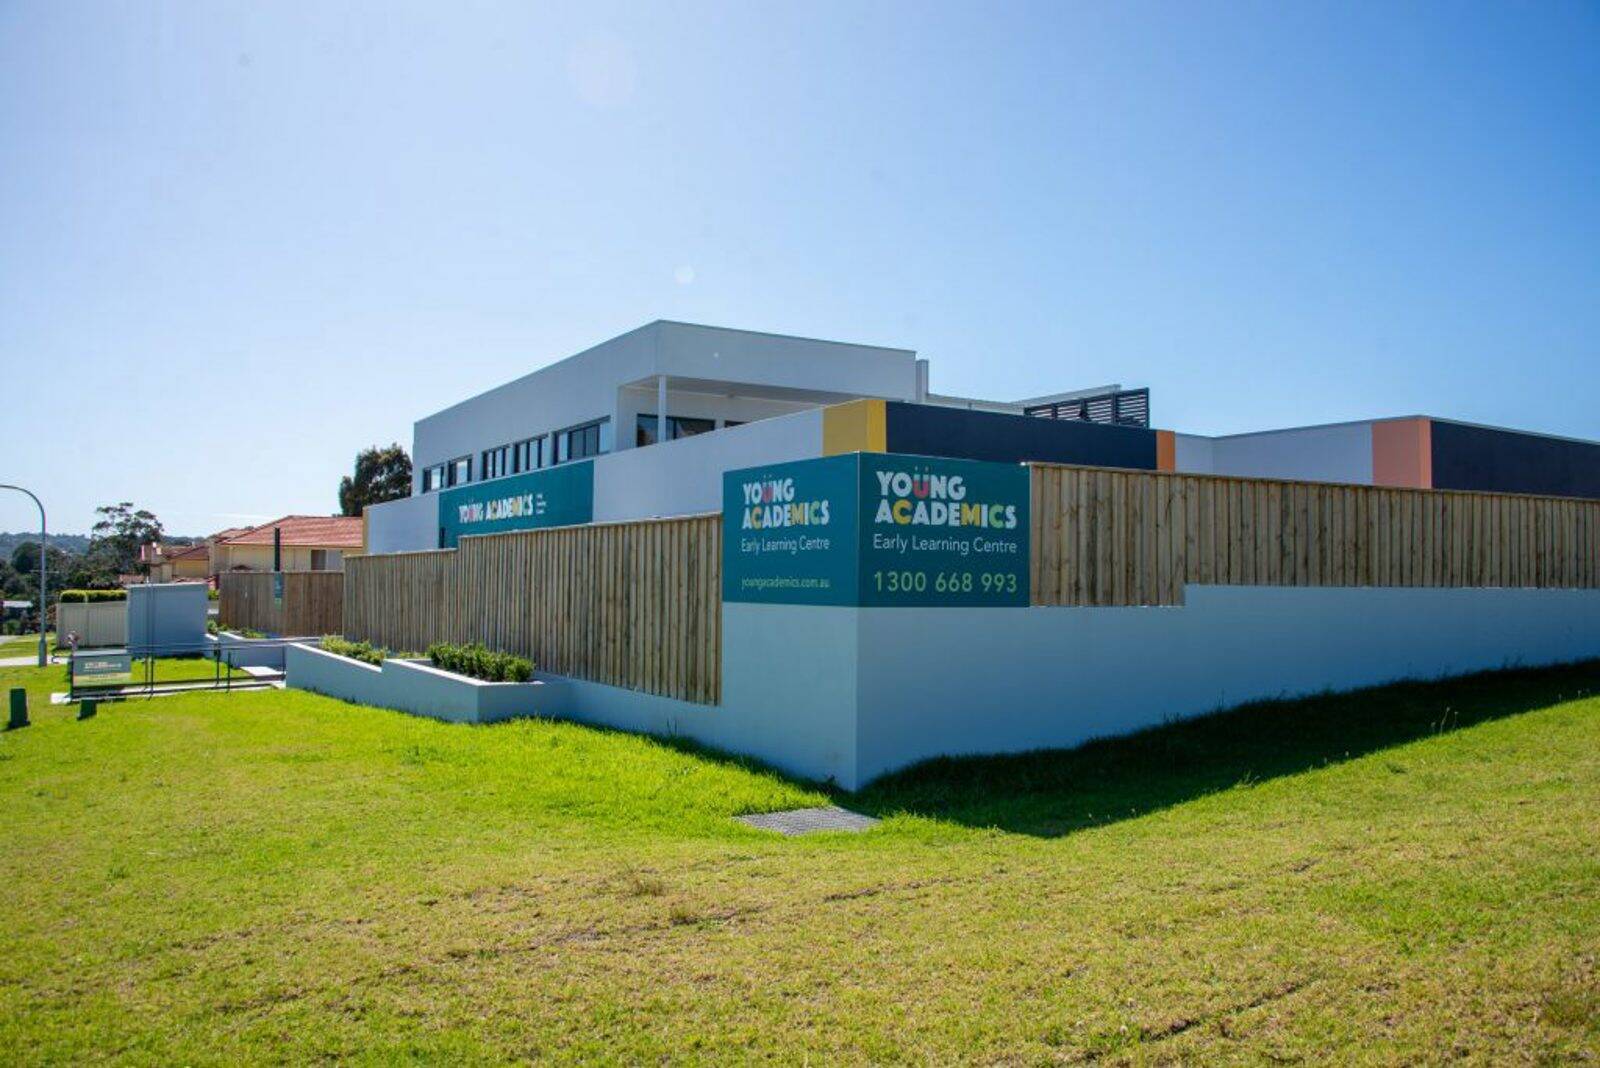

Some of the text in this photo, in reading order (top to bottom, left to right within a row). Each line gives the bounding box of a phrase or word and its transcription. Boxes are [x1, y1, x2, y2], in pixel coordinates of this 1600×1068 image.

[485, 493, 533, 521] ACADEMICS
[742, 500, 830, 529] ACADEMICS
[874, 499, 1017, 529] ACADEMICS
[741, 535, 831, 555] Early Learning Centre
[873, 533, 1018, 555] Early Learning Centre
[741, 575, 831, 591] youngacademics.com.au
[874, 571, 1017, 593] 1300 668 993
